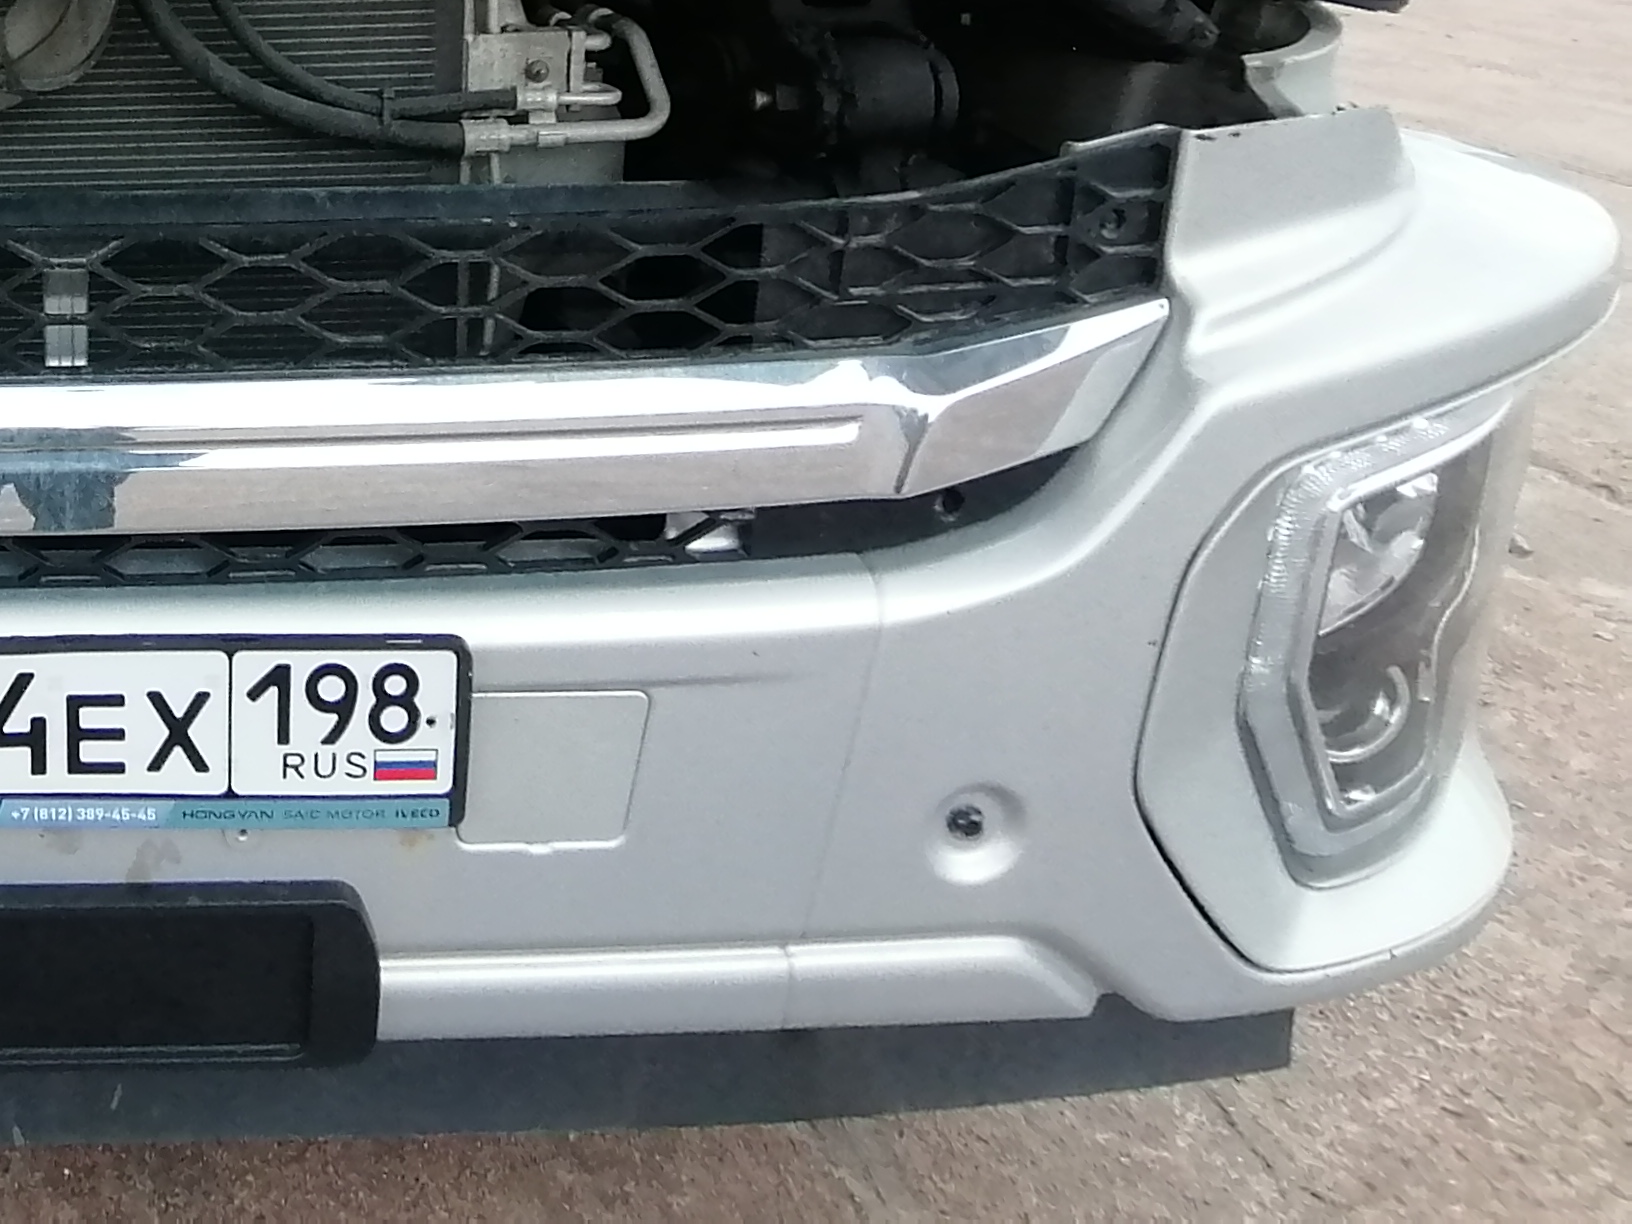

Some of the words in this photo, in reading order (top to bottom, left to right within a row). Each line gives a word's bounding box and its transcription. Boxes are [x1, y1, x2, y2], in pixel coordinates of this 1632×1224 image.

[246, 662, 421, 745] 198
[282, 751, 367, 780] RUS
[11, 807, 29, 820] +7
[34, 806, 73, 822] (812)
[76, 806, 157, 821] 389-45-45
